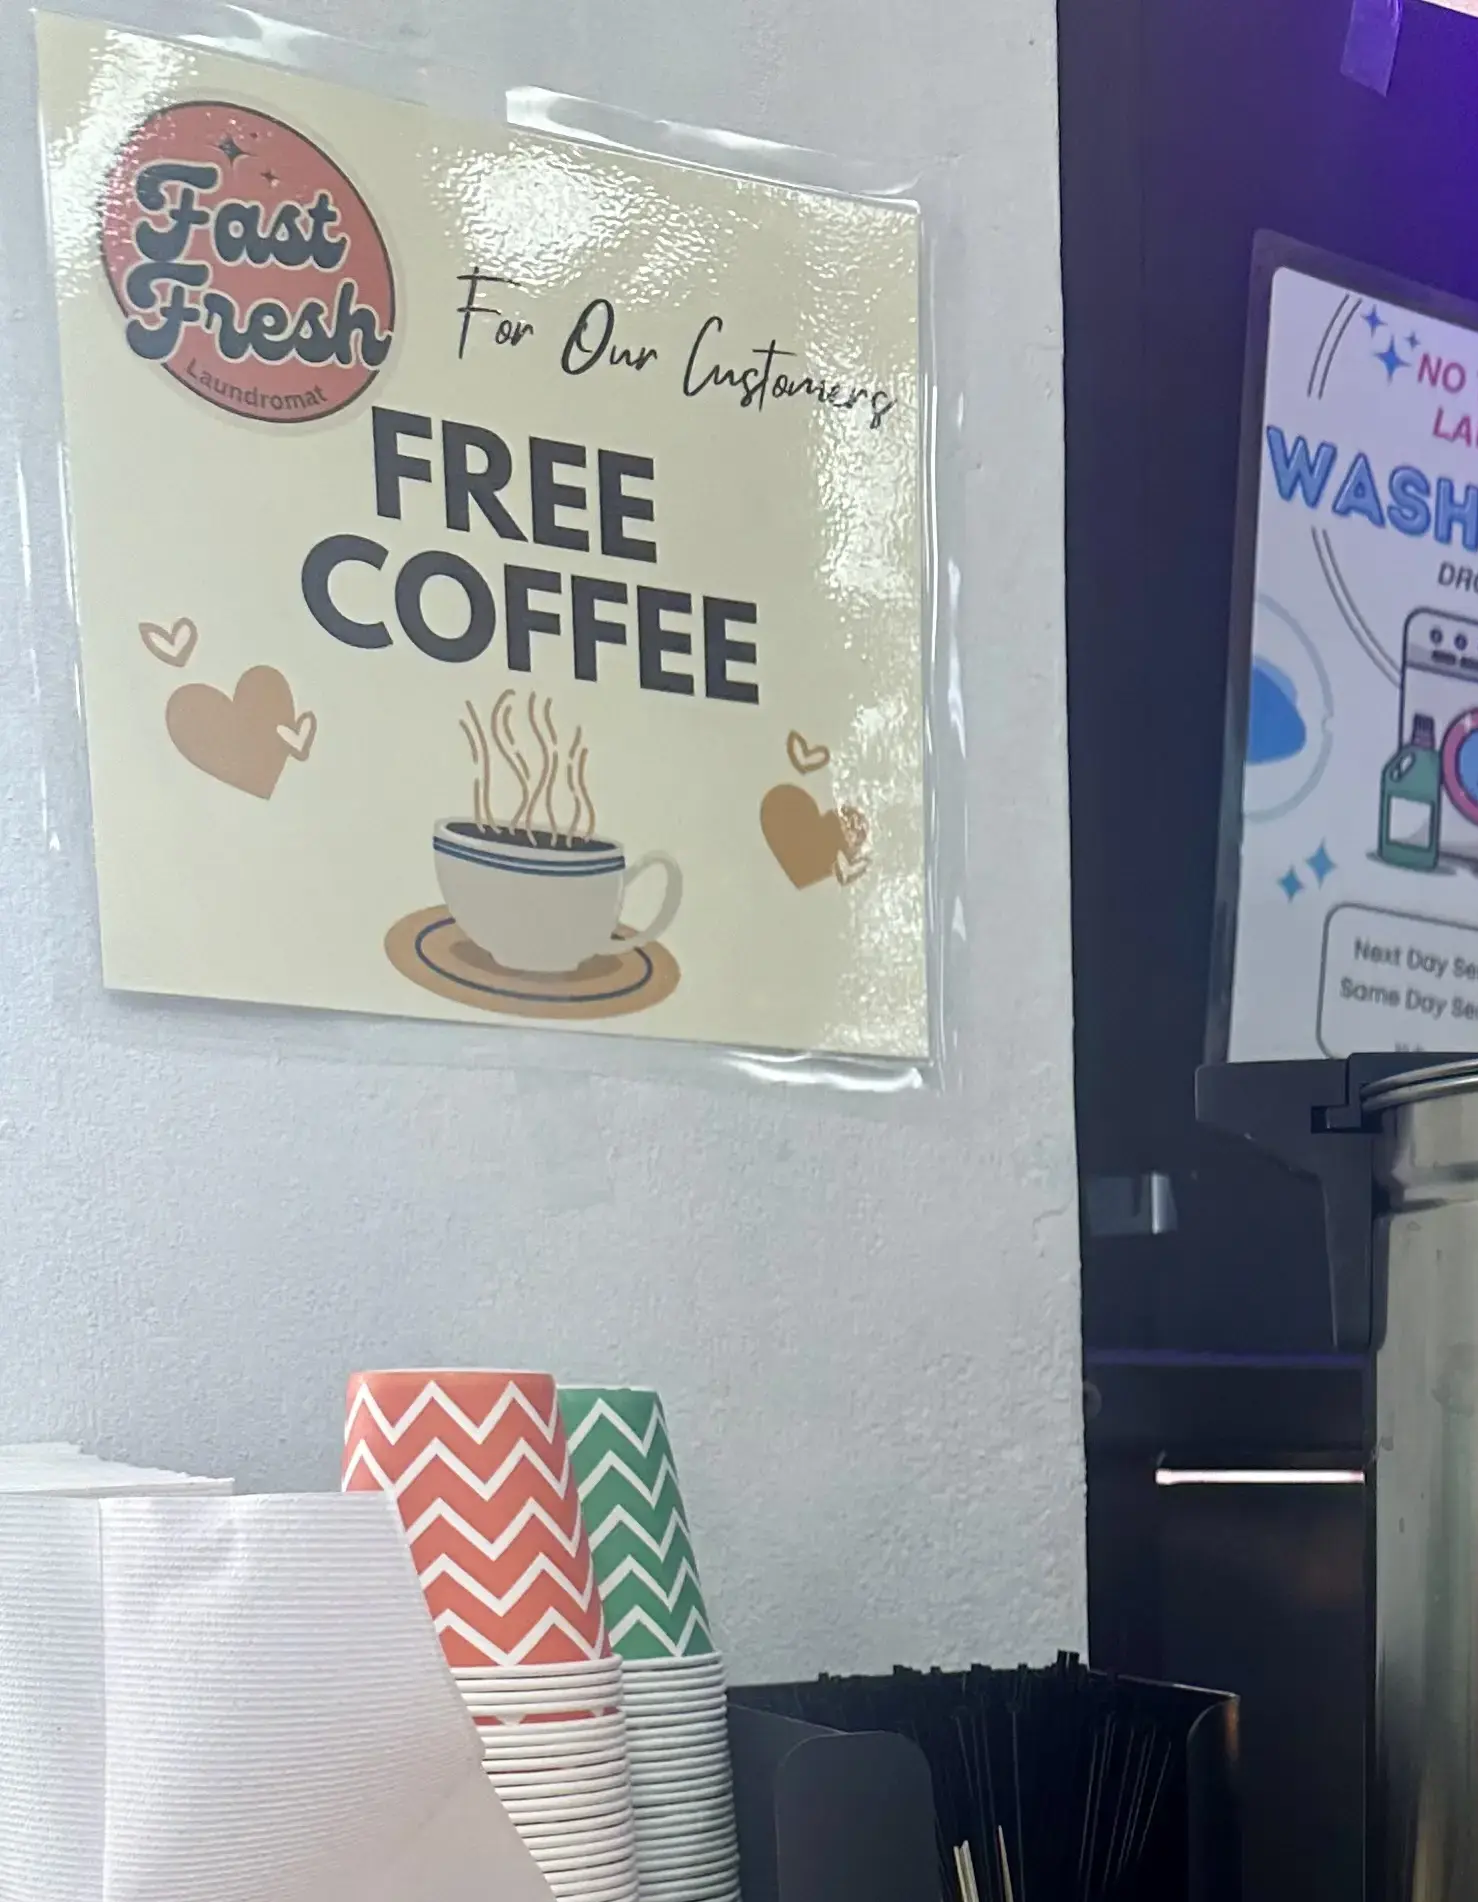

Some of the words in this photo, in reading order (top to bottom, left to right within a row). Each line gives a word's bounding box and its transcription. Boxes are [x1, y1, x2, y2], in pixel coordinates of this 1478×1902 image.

[135, 161, 349, 271] Fast
[125, 261, 392, 368] Fresh
[456, 266, 534, 360] For
[561, 298, 659, 376] Our
[684, 316, 898, 430] Customers
[185, 356, 328, 411] Laundromat
[1418, 353, 1467, 395] NO
[371, 405, 658, 565] FREE
[300, 533, 761, 705] COFFEE
[1340, 976, 1401, 1005] Same
[1404, 987, 1448, 1020] Day
[1354, 937, 1401, 967] Next
[1406, 948, 1448, 979] Day
